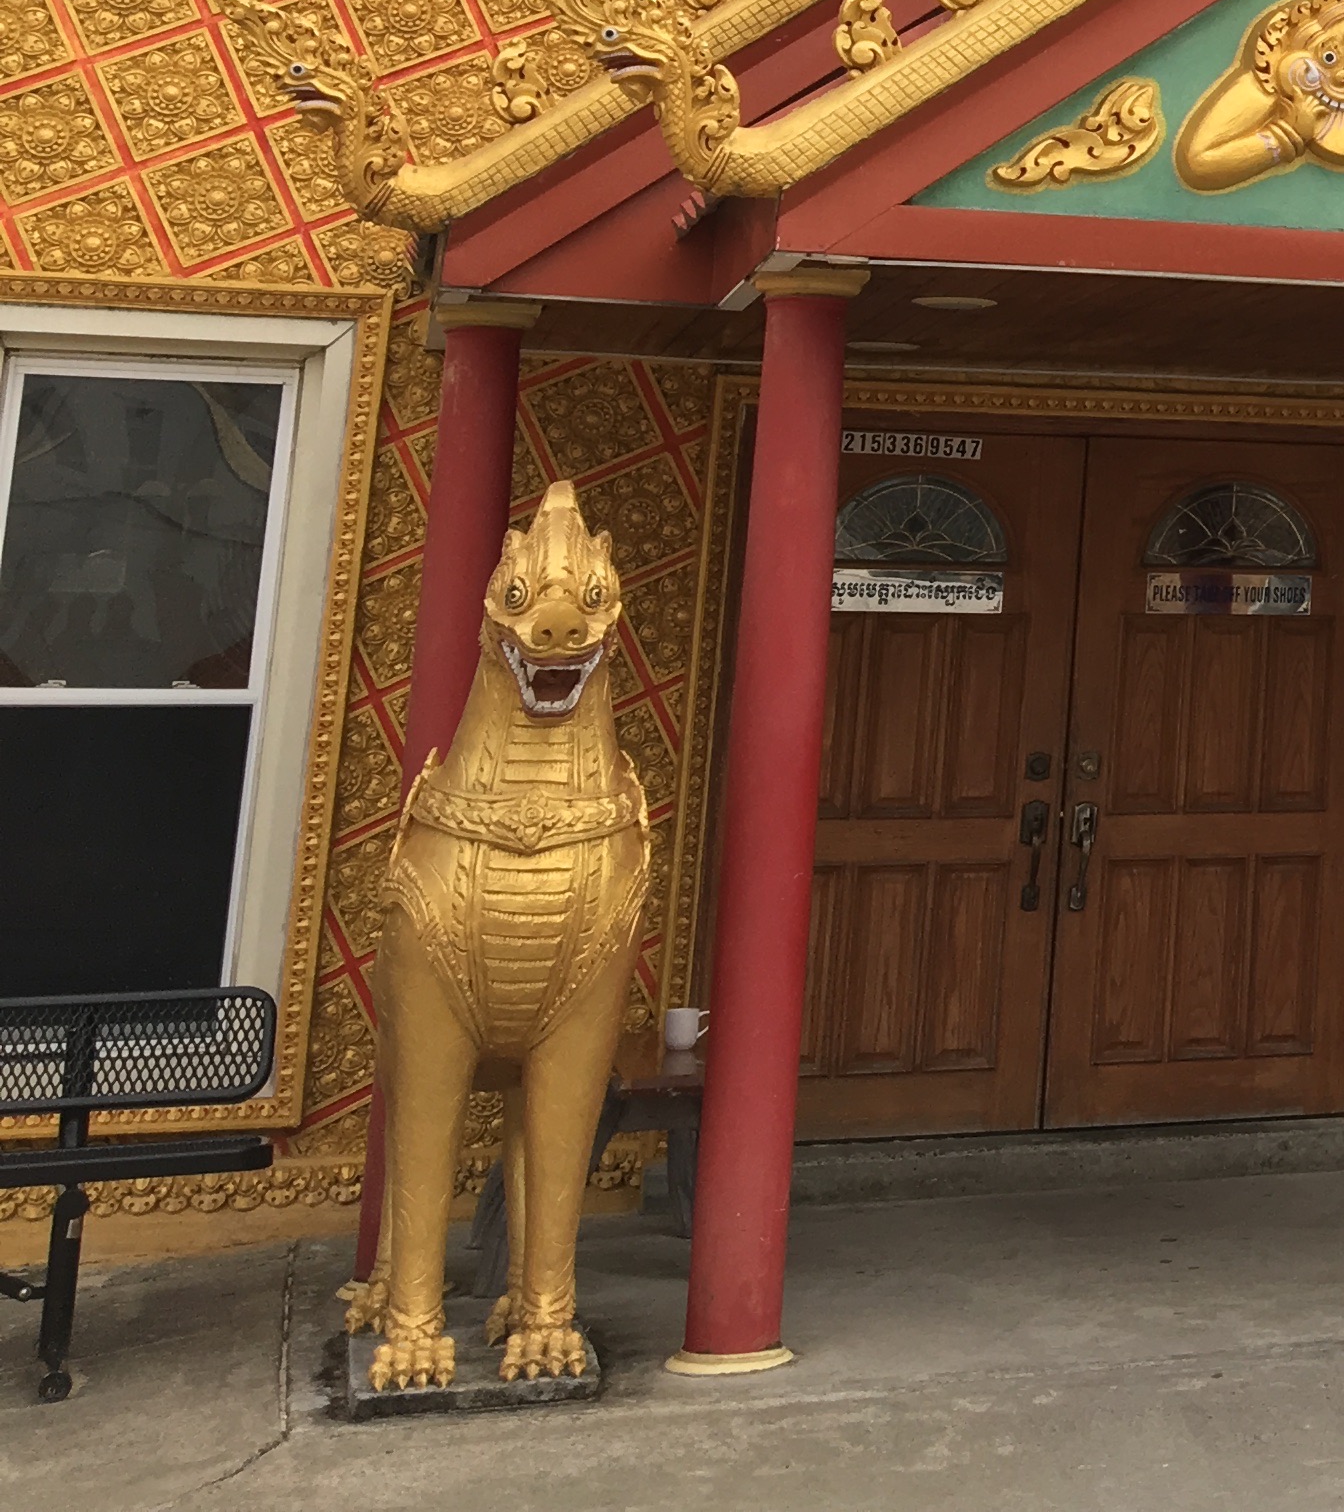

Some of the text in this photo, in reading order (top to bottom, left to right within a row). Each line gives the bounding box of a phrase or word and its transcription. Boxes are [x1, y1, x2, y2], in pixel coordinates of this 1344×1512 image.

[1152, 584, 1190, 603] PLEASE
[1244, 585, 1269, 604] YOUR
[1273, 586, 1306, 604] SHOES
